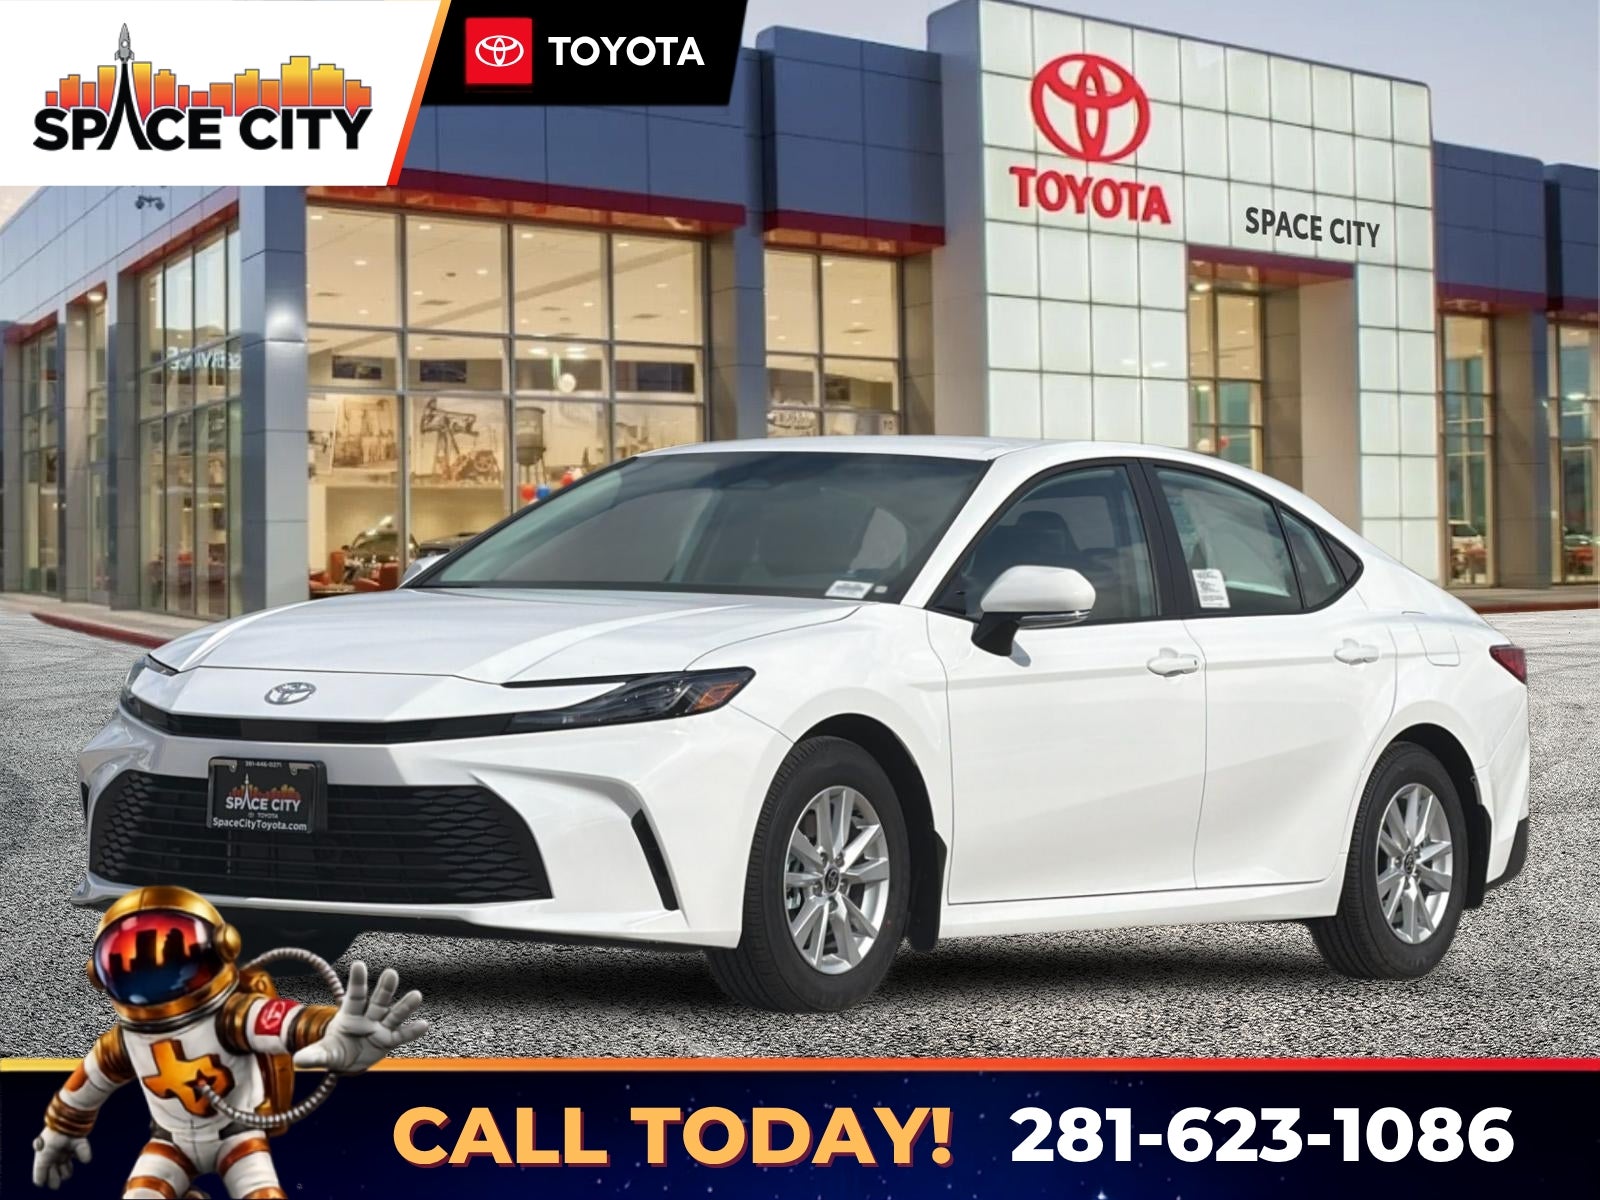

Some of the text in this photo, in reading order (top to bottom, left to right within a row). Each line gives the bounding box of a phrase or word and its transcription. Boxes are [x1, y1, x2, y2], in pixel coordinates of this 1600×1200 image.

[1009, 166, 1171, 224] TOYOTA
[1245, 206, 1381, 248] SPACE CITY
[225, 793, 301, 812] SPACE CITY
[213, 817, 307, 831] SpaceCityToyota.com
